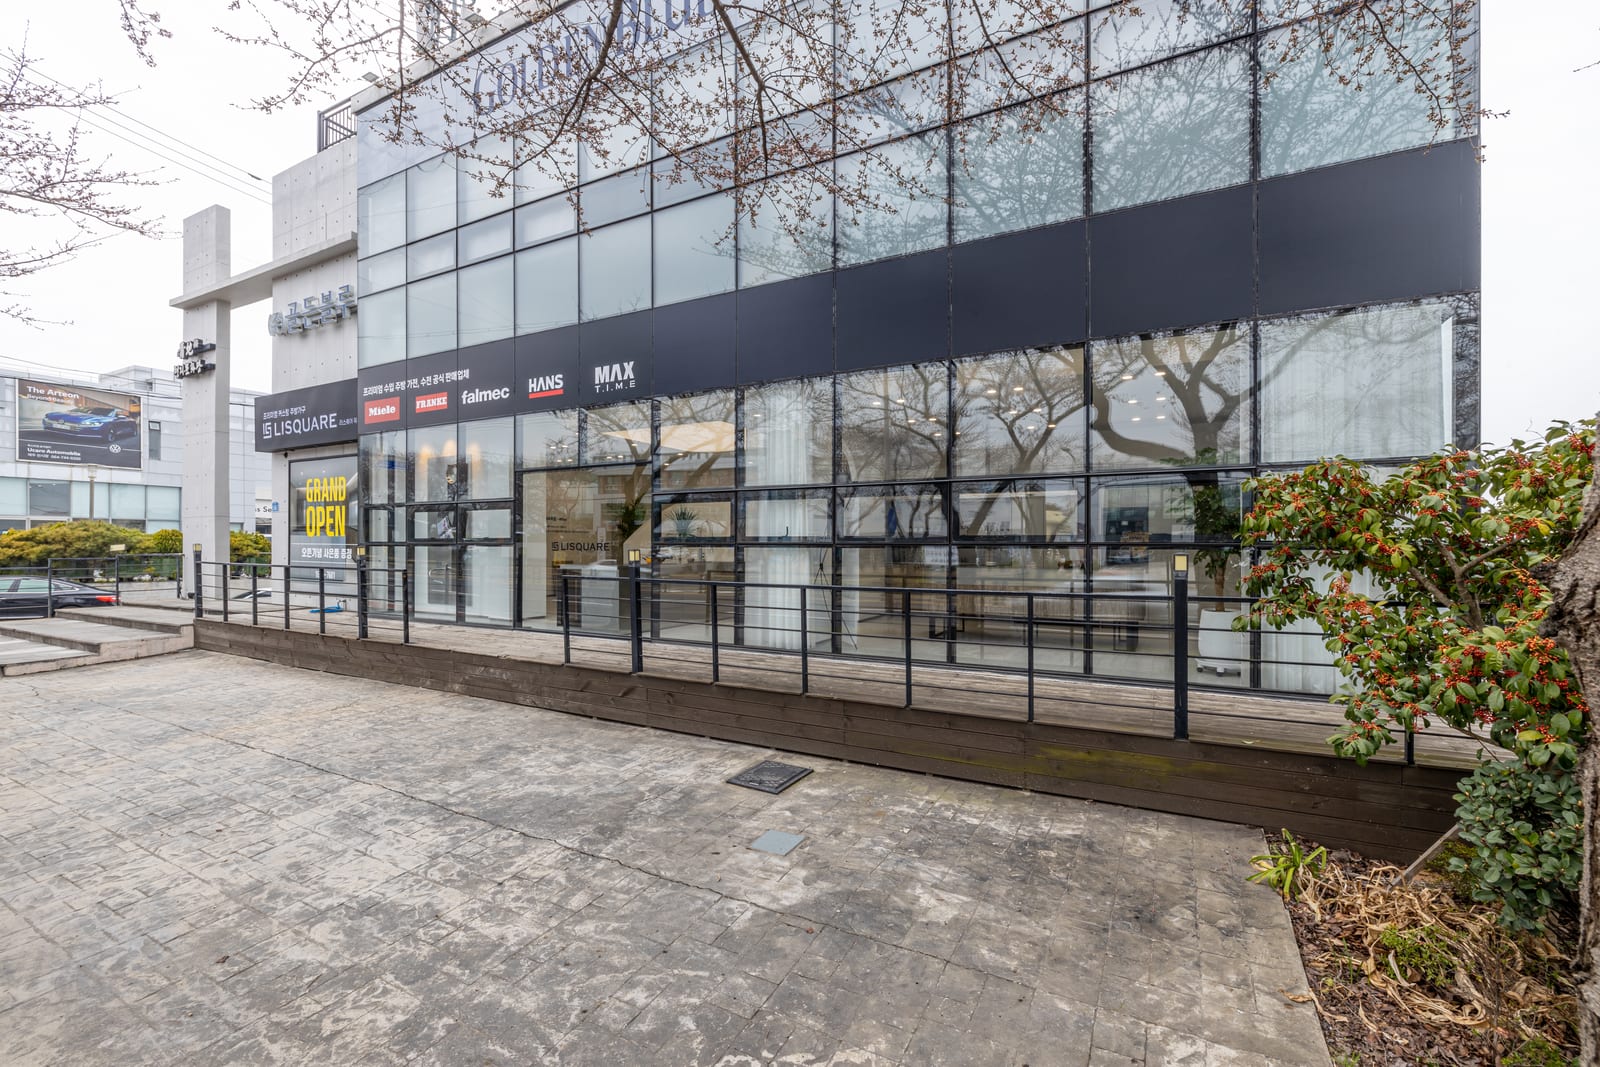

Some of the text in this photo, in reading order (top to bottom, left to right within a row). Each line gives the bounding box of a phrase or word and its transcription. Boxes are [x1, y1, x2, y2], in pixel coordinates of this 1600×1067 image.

[594, 360, 635, 384] MAX
[27, 386, 80, 399] The Arteon
[363, 384, 383, 396] 프리미엄
[384, 382, 394, 393] 수입
[395, 381, 406, 392] 주방
[420, 376, 432, 387] 수전
[433, 373, 444, 385] 공식
[528, 373, 564, 393] HANS
[416, 396, 447, 409] FRANKE
[461, 386, 510, 405] falmec
[368, 404, 396, 417] Miele
[274, 413, 337, 436] LISQUARE
[306, 476, 347, 502] GRAND
[305, 505, 346, 538] OPEN
[301, 547, 322, 559] 오픈기념
[323, 547, 339, 559] 사은품
[560, 542, 610, 552] LISQUARE
